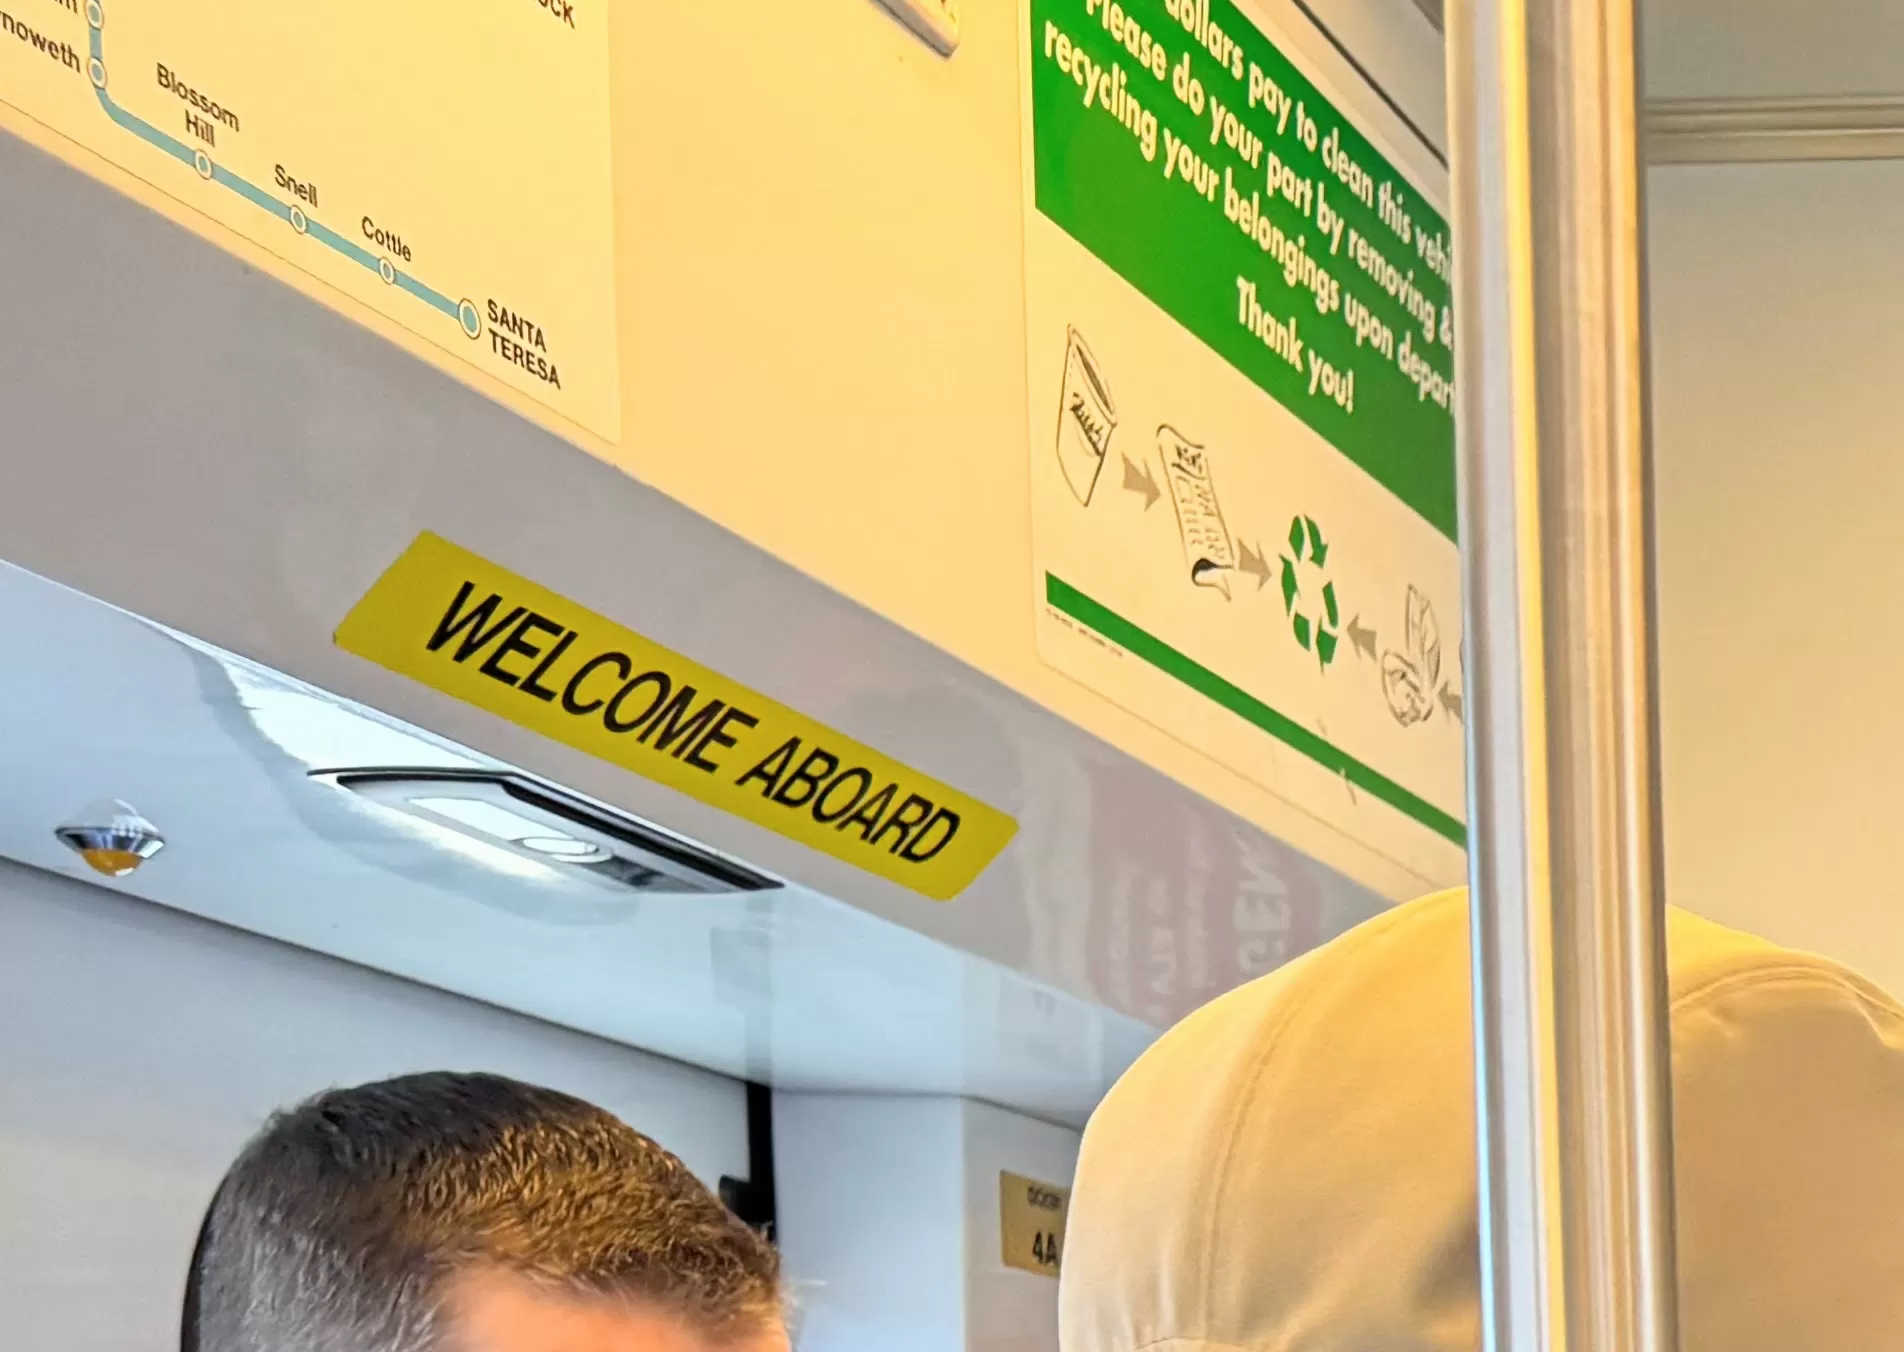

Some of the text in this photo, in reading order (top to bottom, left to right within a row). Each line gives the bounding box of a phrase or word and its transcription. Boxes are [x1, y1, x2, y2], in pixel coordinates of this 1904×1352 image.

[0, 10, 80, 75] noweth
[157, 62, 240, 132] Blossom
[185, 109, 215, 147] Hill
[1249, 62, 1291, 135] pay
[1297, 101, 1317, 151] to
[1322, 127, 1373, 208] clean
[1378, 181, 1411, 244] this
[275, 164, 318, 208] Snell
[1045, 20, 1157, 162] recycling
[1163, 128, 1219, 204] your
[1224, 166, 1340, 314] belongings
[1344, 292, 1393, 360] upon
[1173, 52, 1205, 115] do
[1210, 96, 1263, 169] your
[1267, 152, 1313, 217] part
[1317, 182, 1344, 255] by
[1348, 228, 1435, 344] removing
[362, 216, 411, 262] Cottle
[488, 299, 546, 352] SANTA
[1237, 275, 1354, 414] Thank you!
[488, 328, 561, 390] TERESA
[425, 581, 960, 864] WELCOME ABOARD
[1032, 1231, 1059, 1265] 4A
